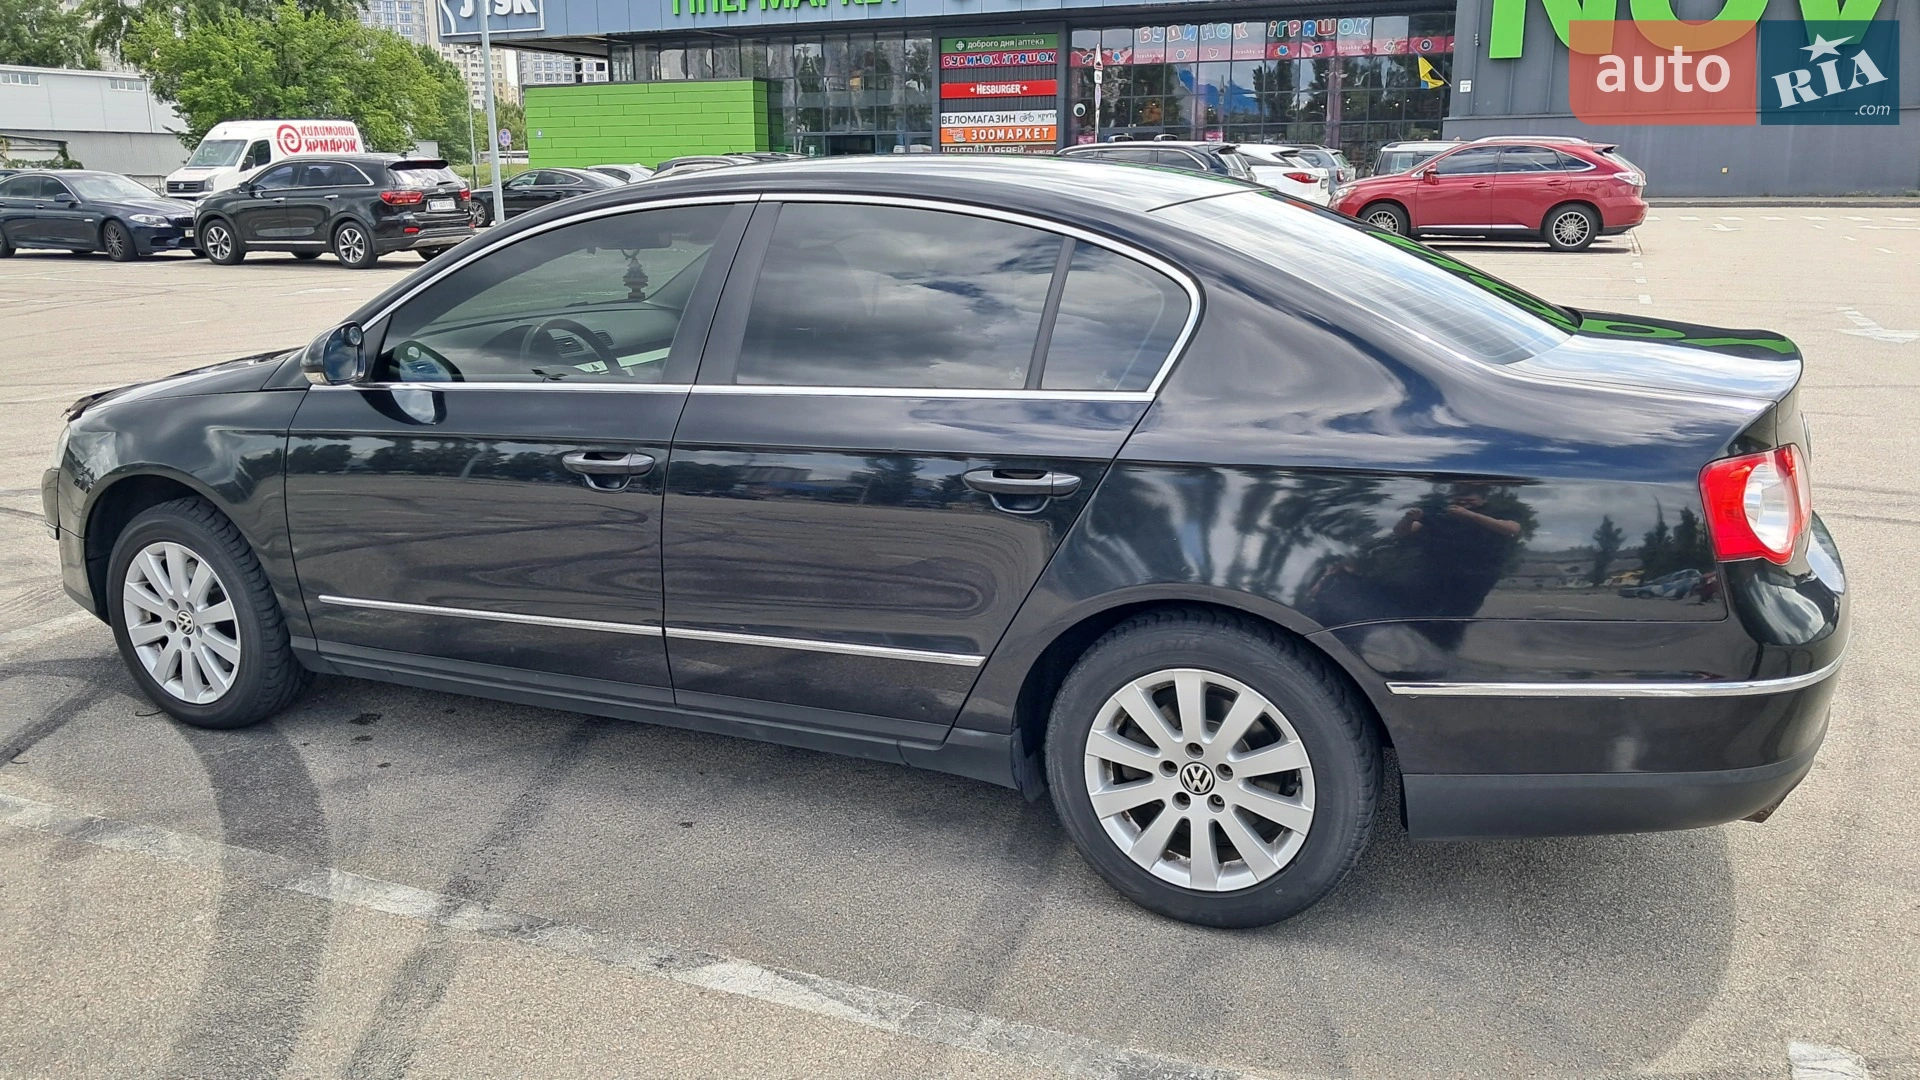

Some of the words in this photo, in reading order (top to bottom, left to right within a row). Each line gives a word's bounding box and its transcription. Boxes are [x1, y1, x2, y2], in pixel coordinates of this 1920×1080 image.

[967, 39, 999, 49] доброго
[942, 53, 1000, 67] БУДИНОК
[941, 114, 1016, 125] ВЕЛОМАГАЗИН
[971, 127, 1049, 140] ЗООМАРКЕТ
[304, 138, 358, 153] ЯРМАРОК
